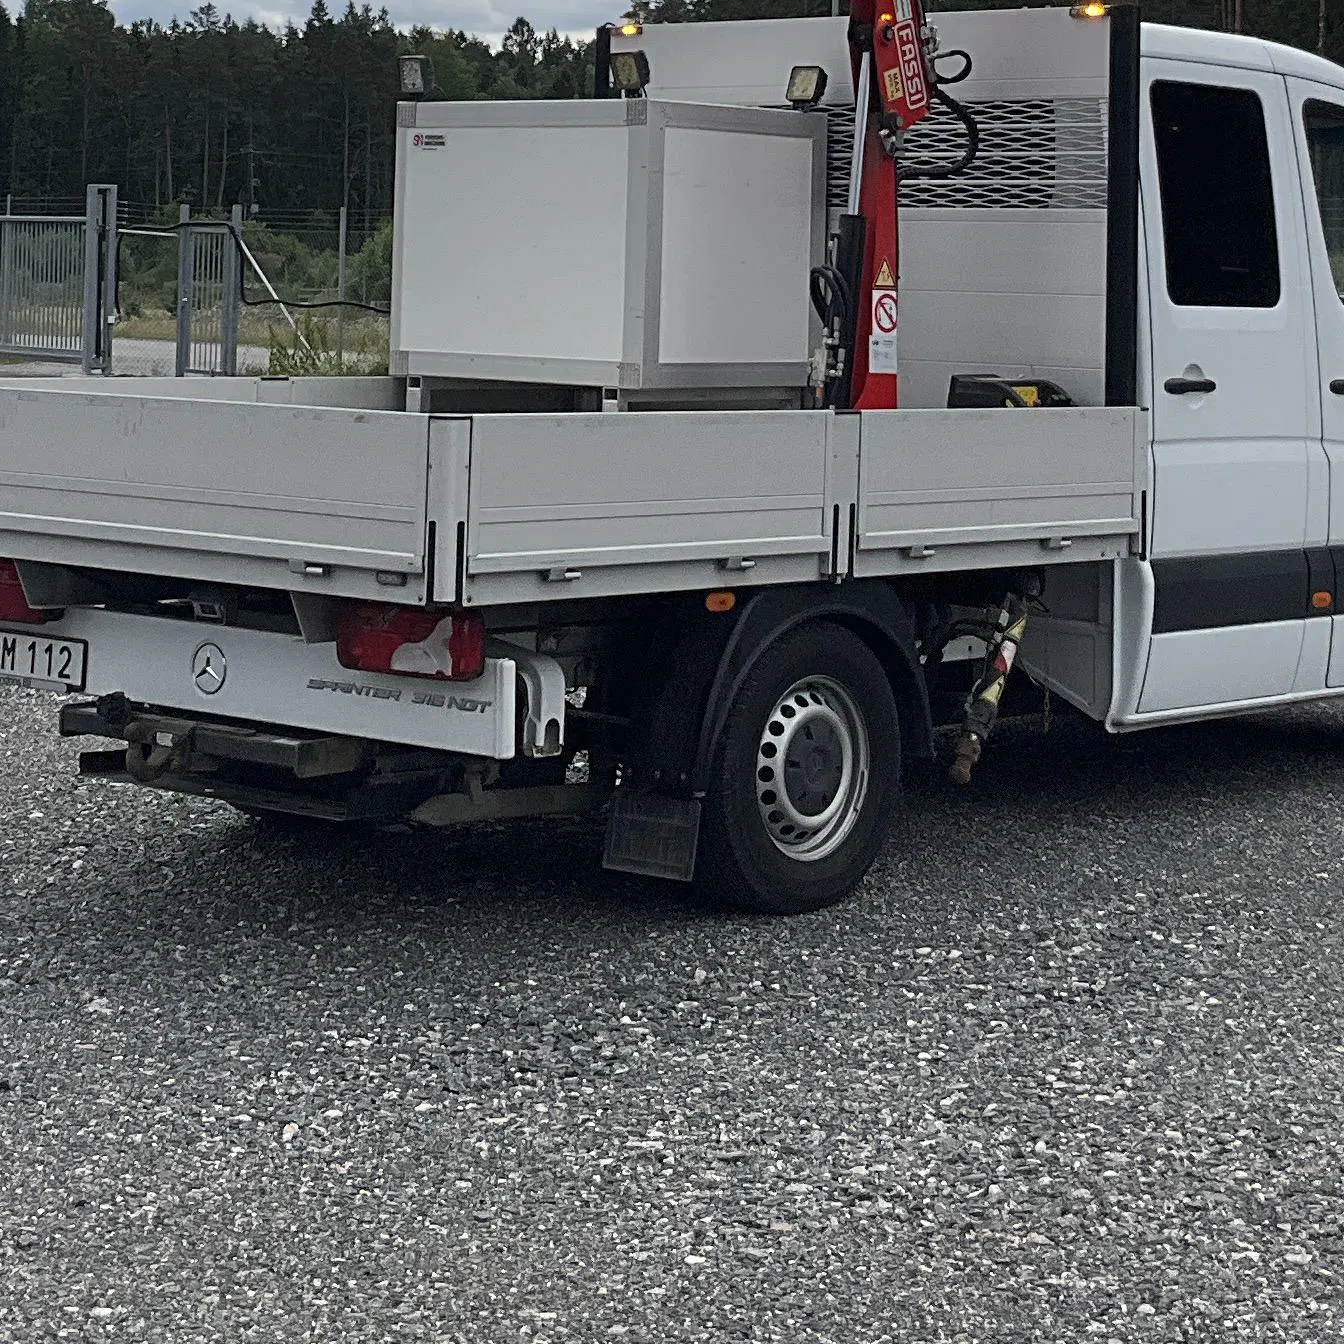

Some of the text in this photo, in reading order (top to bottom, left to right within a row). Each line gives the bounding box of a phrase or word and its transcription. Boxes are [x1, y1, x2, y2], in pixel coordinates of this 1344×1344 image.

[899, 29, 923, 101] FASSI
[28, 641, 72, 679] 112
[306, 679, 402, 702] SPRINTER
